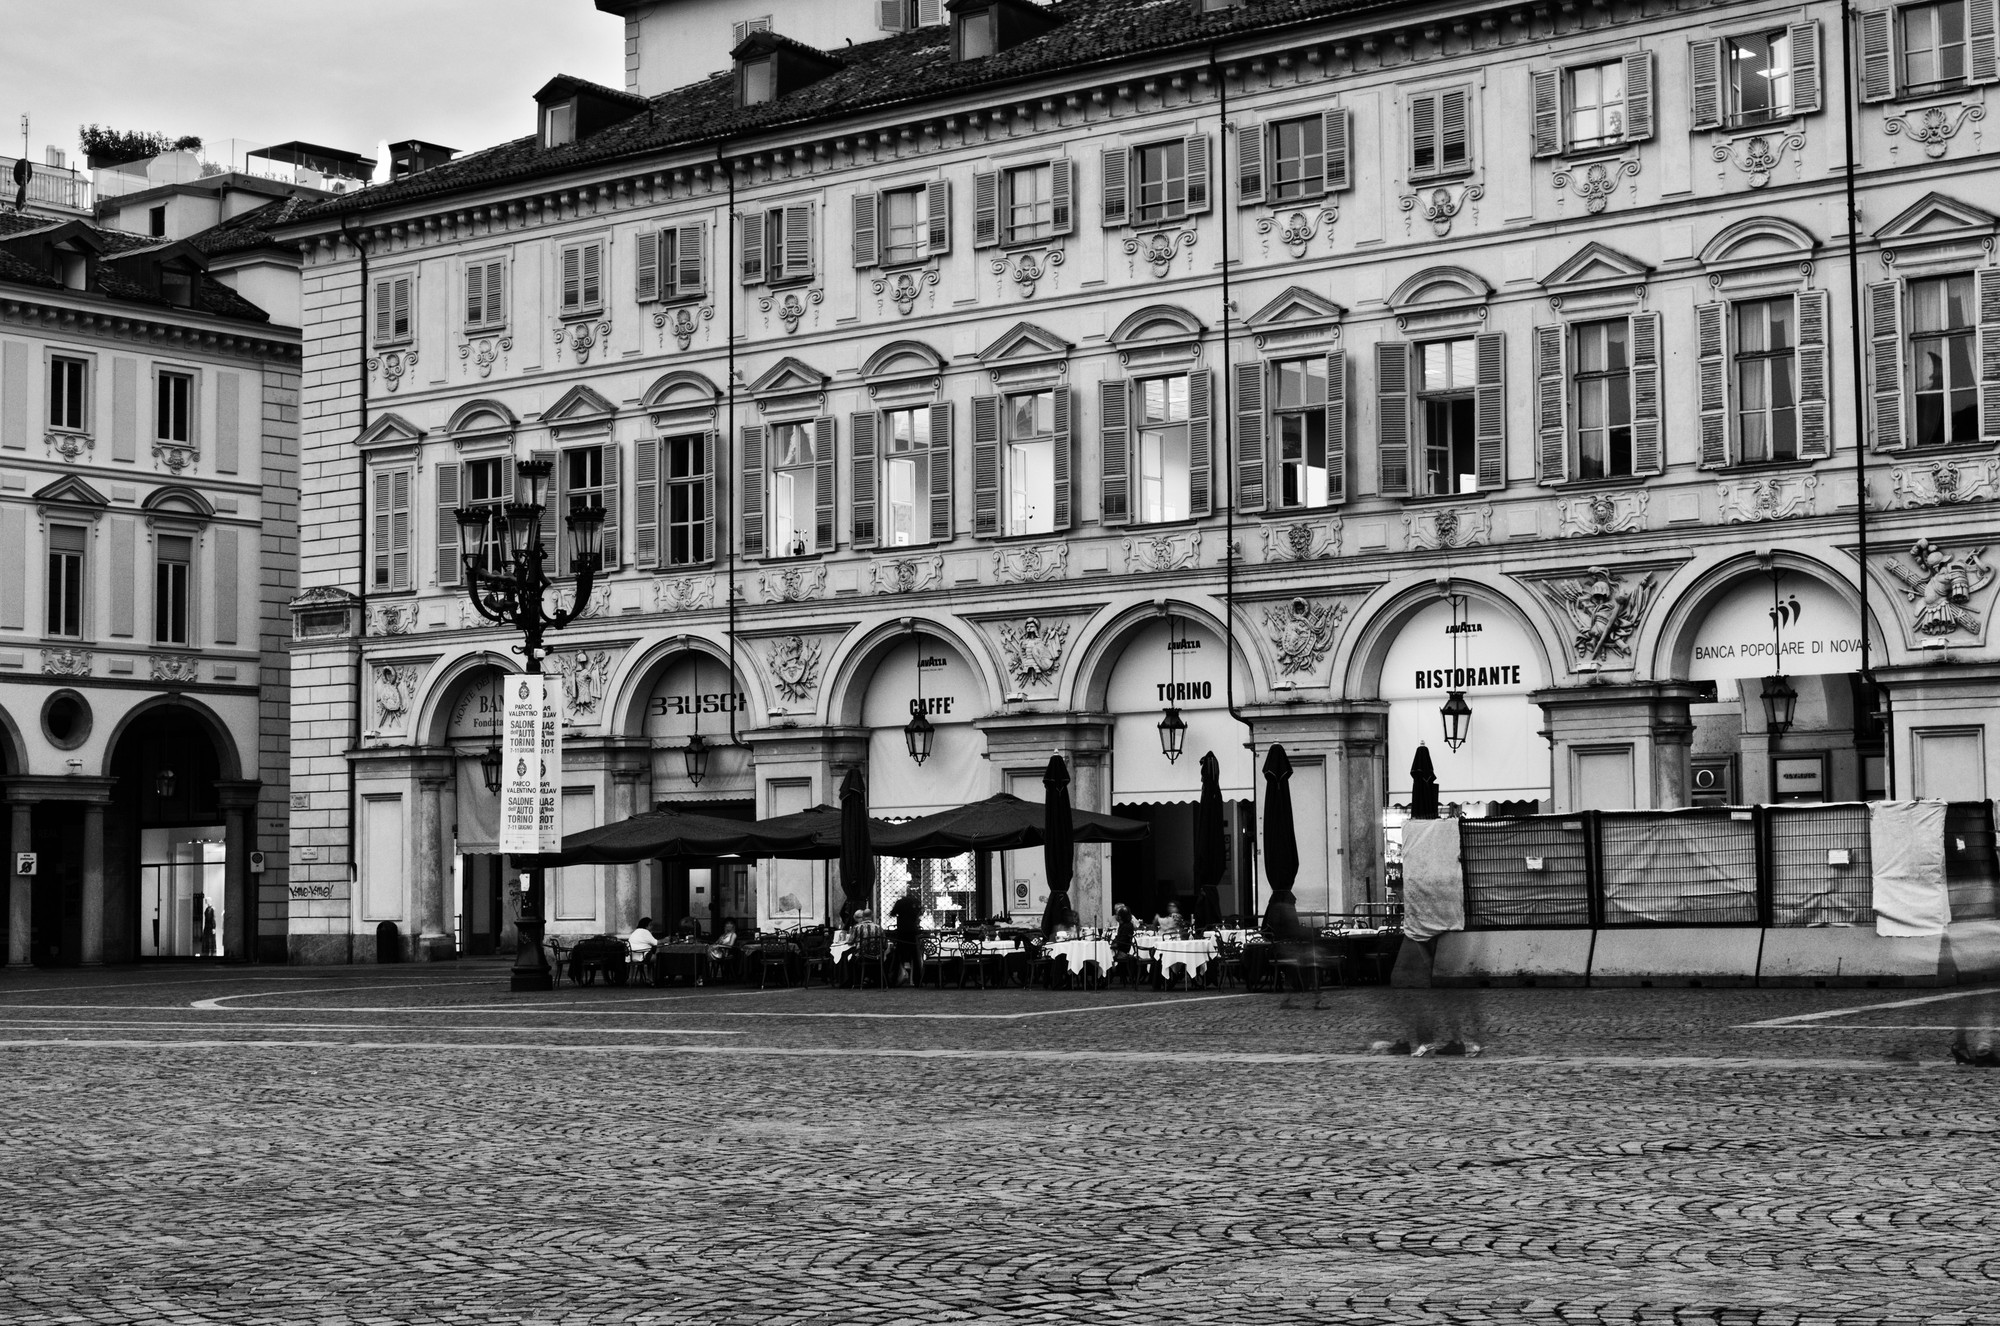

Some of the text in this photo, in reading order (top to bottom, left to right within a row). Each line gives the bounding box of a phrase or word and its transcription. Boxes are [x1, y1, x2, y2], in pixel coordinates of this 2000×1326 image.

[1445, 621, 1482, 634] LAVAZZA
[1167, 638, 1201, 650] LAVAZZA
[1695, 645, 1736, 660] BANCA
[1740, 641, 1805, 657] POPOLARE
[1811, 640, 1824, 654] DI
[917, 656, 947, 667] LAVAZZA
[1415, 665, 1521, 689] RISTORANTE
[1157, 681, 1212, 701] TORINO
[454, 690, 477, 727] MONTE
[910, 696, 954, 715] CAFFE'
[510, 720, 535, 729] SALONE
[510, 738, 535, 747] TORINO
[508, 797, 534, 806] SALONE
[507, 815, 534, 823] TORINO
